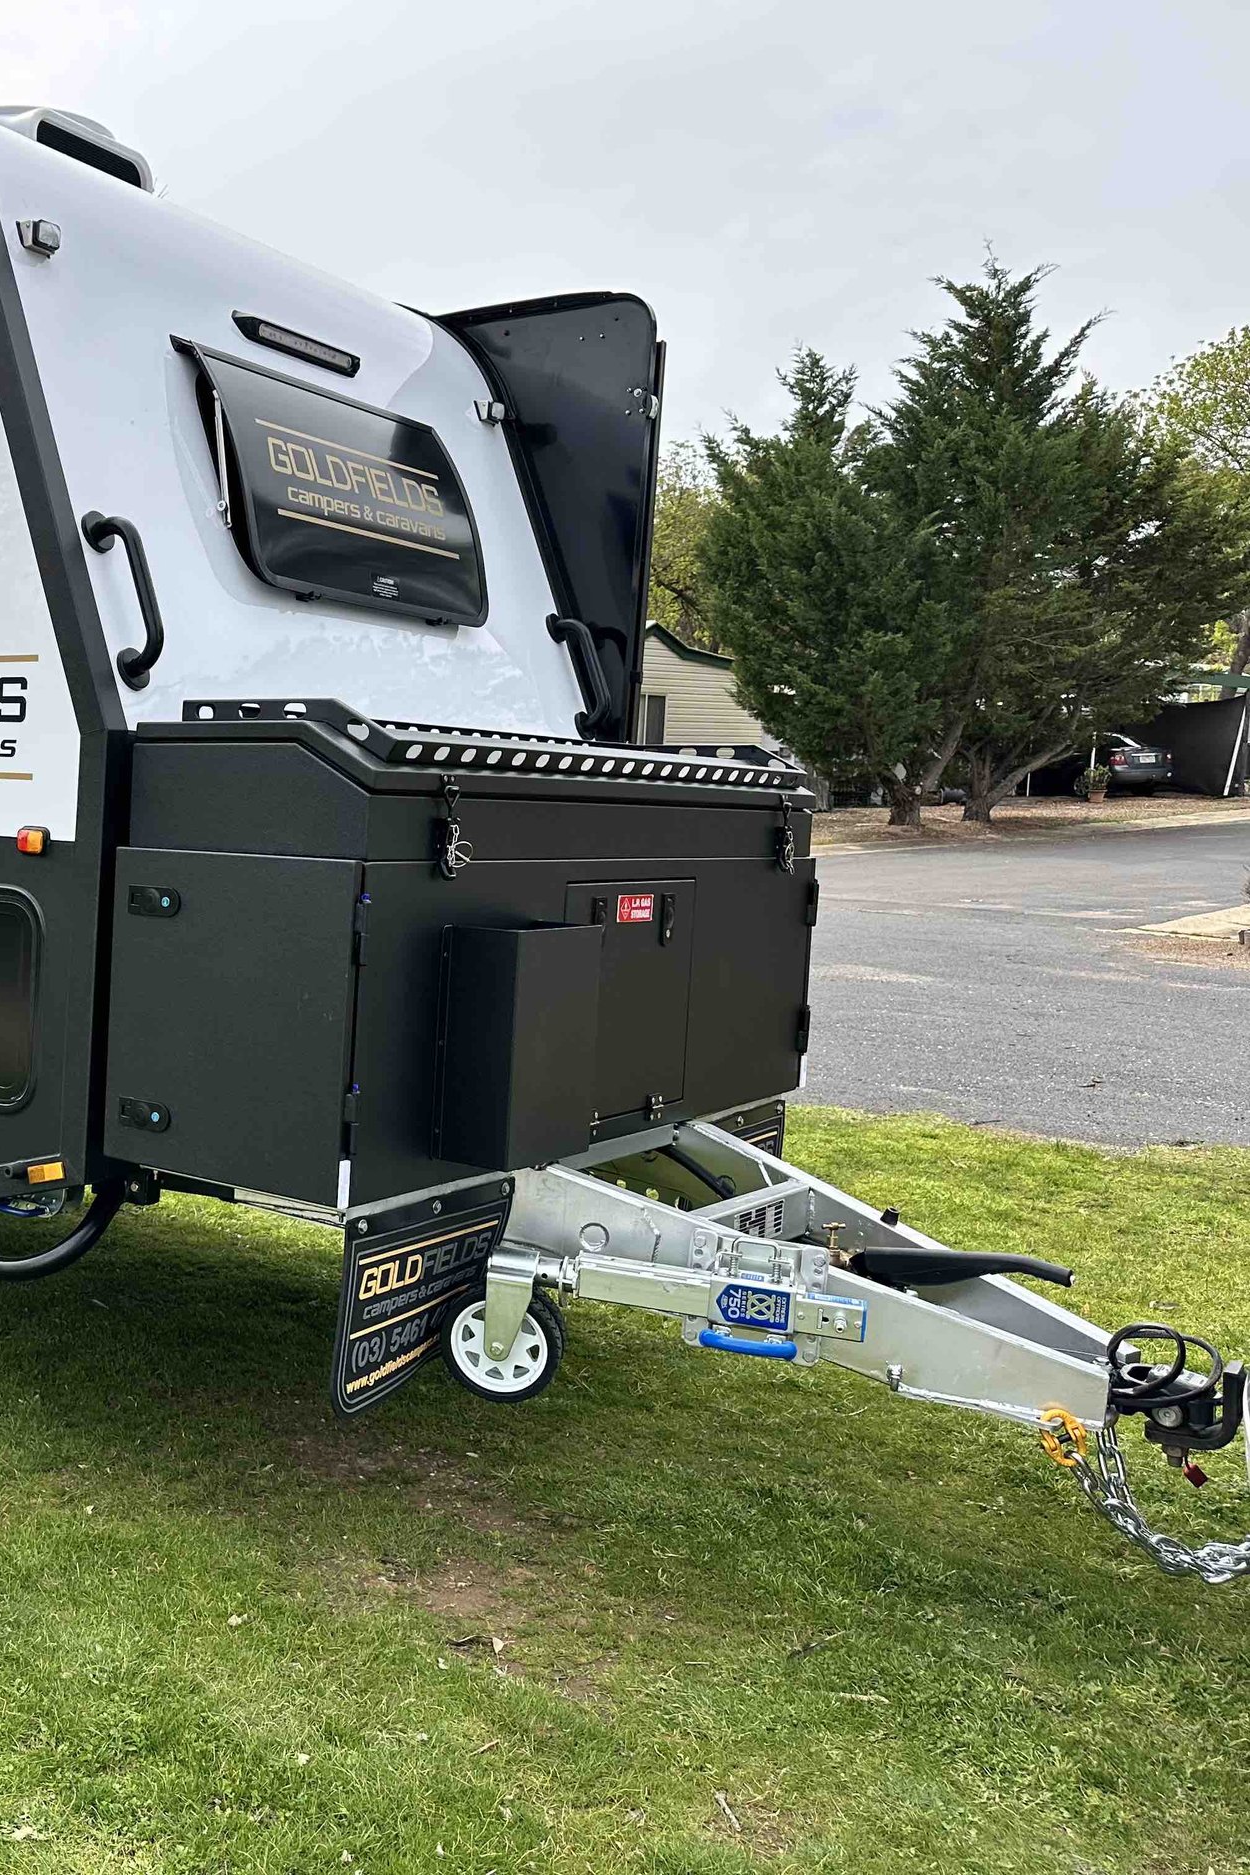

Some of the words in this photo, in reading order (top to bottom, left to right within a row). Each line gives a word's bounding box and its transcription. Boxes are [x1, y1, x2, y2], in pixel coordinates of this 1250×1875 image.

[267, 436, 444, 517] GOLDFIELDS
[287, 486, 361, 521] campers
[363, 505, 374, 521] &
[376, 510, 446, 541] caravans
[641, 897, 651, 907] GAS
[358, 1231, 492, 1301] GOLDFIELDS
[728, 1289, 742, 1319] 750
[352, 1331, 385, 1373] (03)
[390, 1313, 429, 1353] 5461
